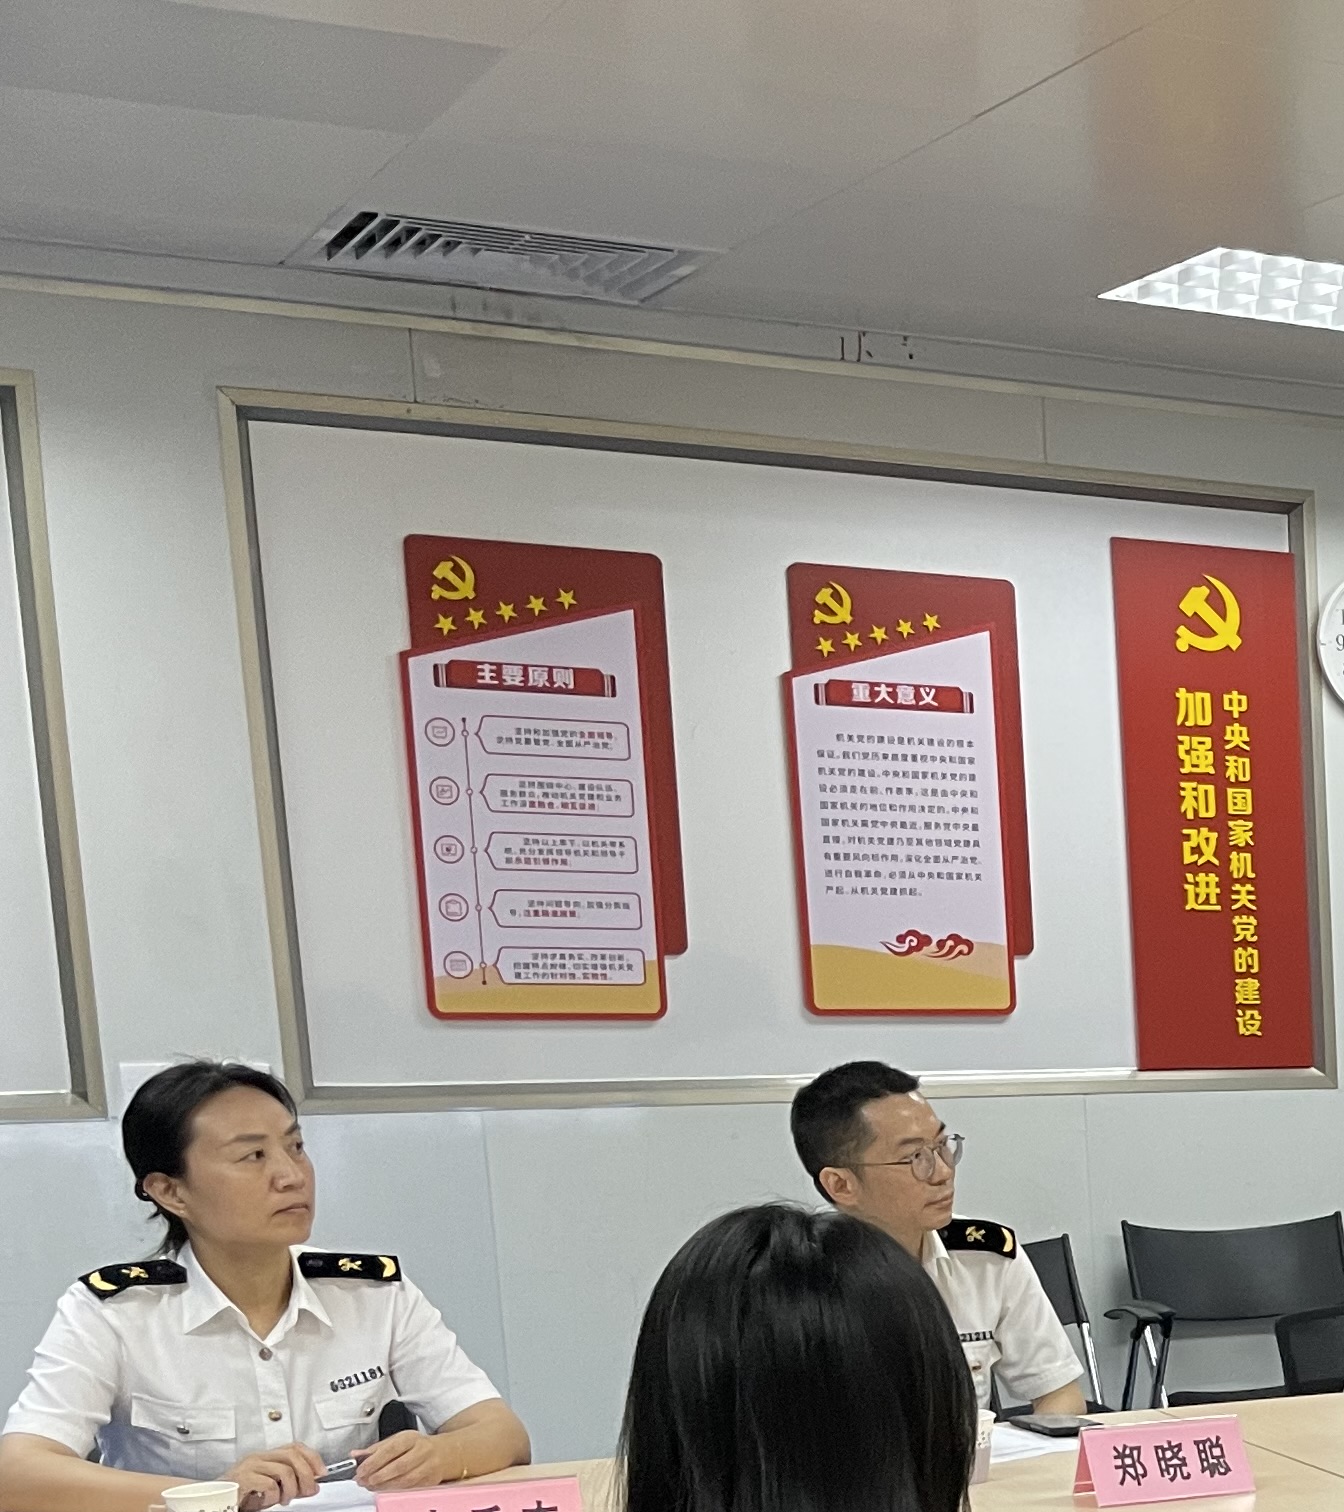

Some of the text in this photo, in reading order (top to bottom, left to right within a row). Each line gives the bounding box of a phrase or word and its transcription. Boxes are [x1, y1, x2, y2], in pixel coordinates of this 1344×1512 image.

[476, 662, 575, 690] 主要原则
[851, 681, 939, 708] 重大意义
[1175, 687, 1222, 912] 加强和改进
[1222, 690, 1263, 1037] 中央和国家机关党的建设
[1113, 1435, 1232, 1487] 郑晓聪
